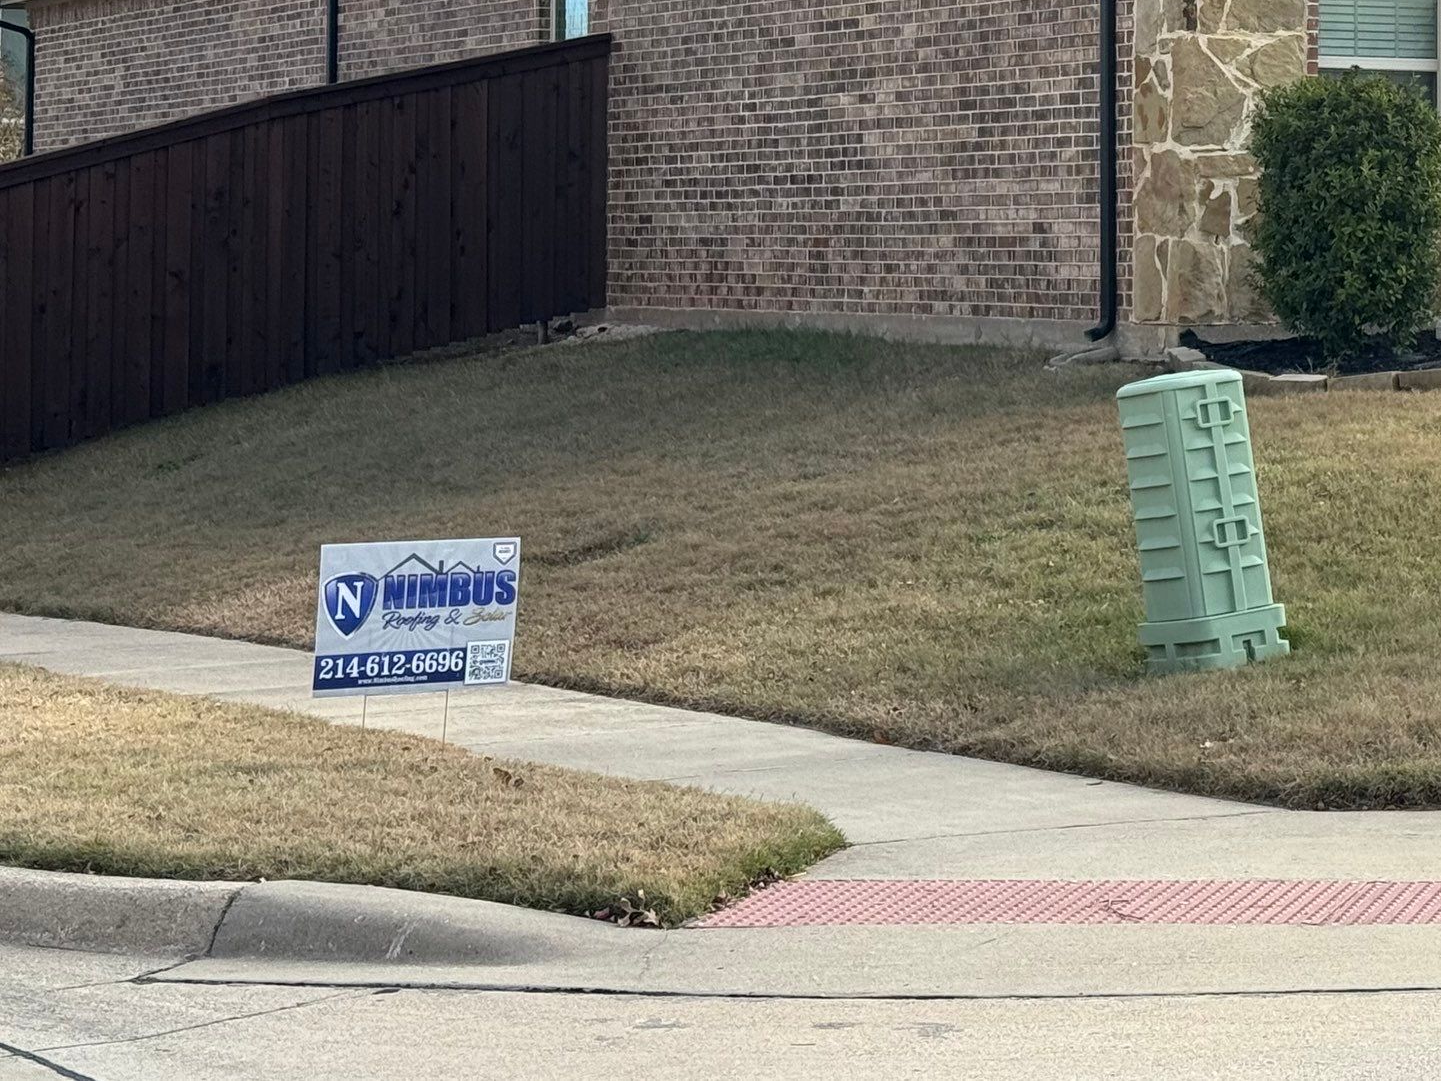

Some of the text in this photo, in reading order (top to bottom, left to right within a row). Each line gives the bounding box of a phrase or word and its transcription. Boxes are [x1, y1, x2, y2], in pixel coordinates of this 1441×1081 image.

[335, 581, 364, 620] N
[383, 570, 517, 610] NIMBUS
[382, 611, 440, 632] Roofing
[444, 608, 463, 625] &
[318, 650, 464, 679] 214-612-6696
